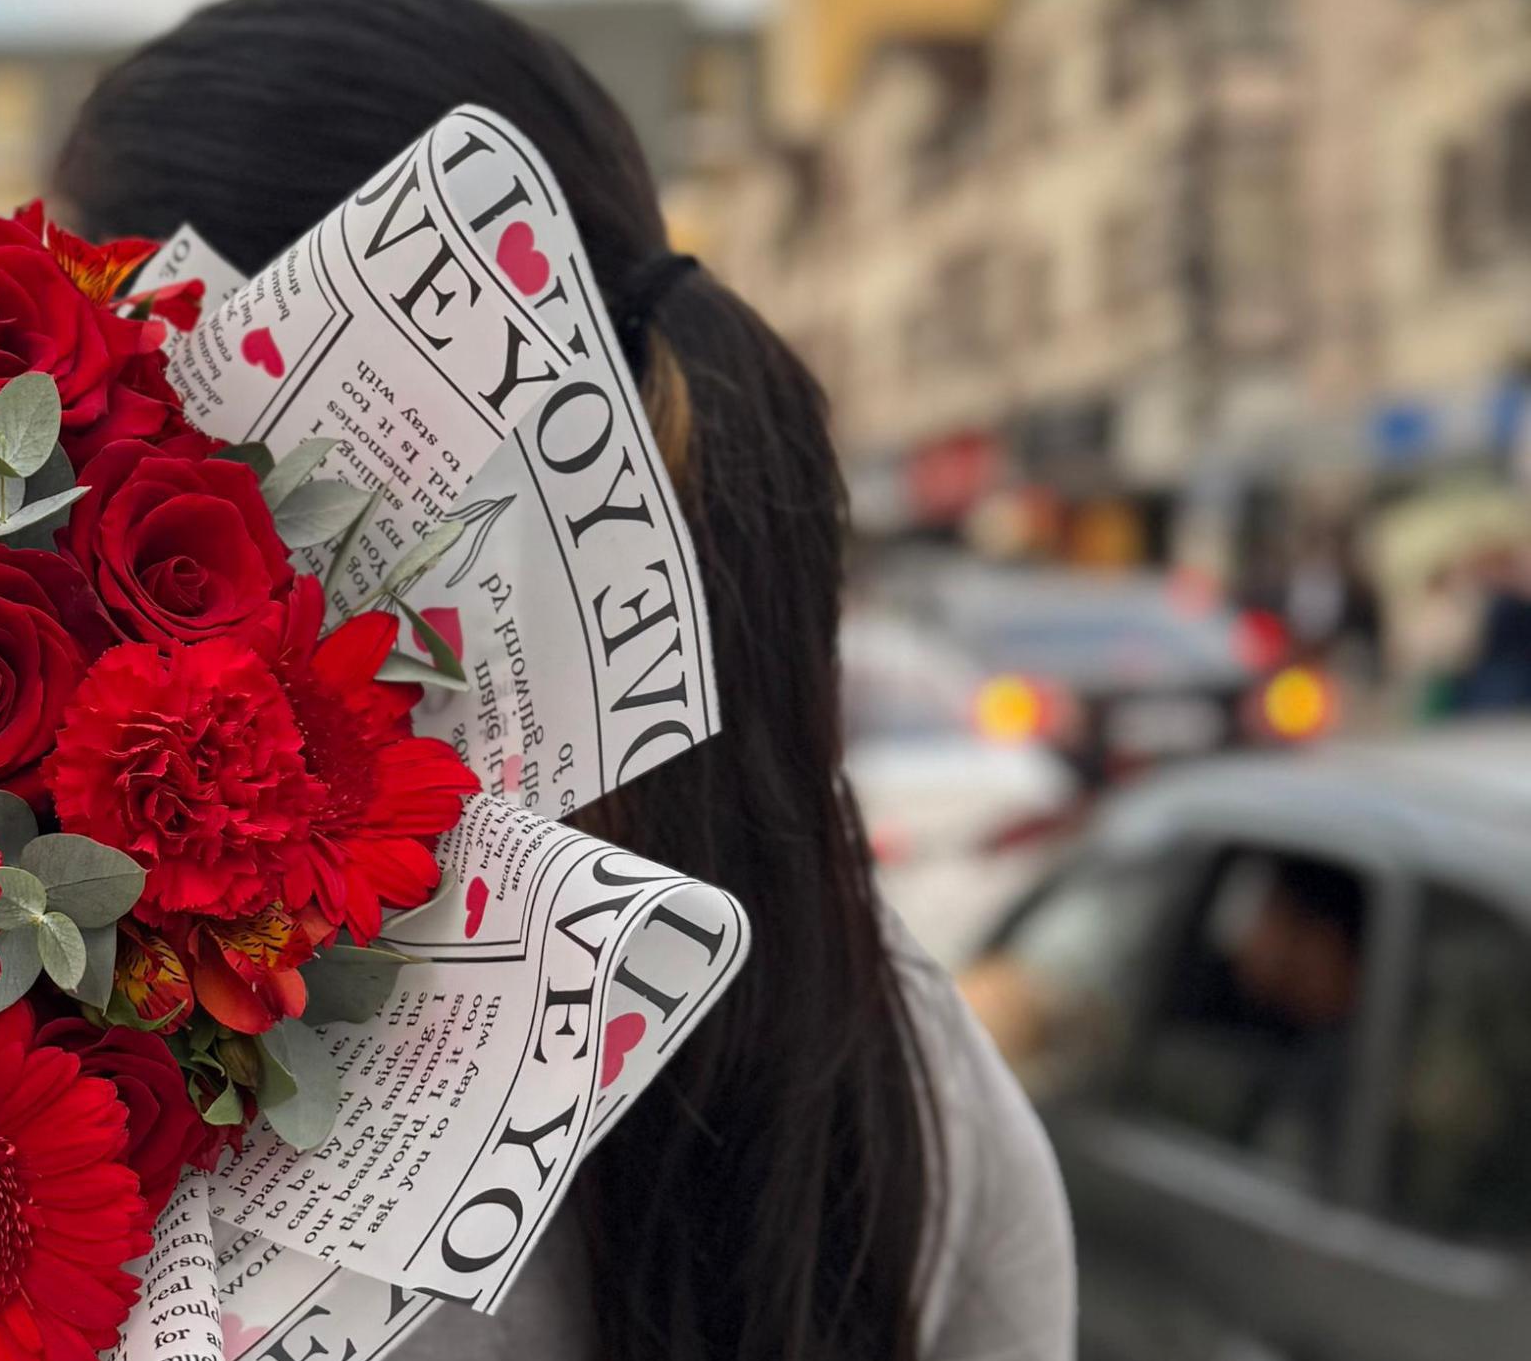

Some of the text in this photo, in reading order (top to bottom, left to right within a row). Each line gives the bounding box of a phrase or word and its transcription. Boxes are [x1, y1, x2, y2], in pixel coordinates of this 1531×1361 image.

[341, 381, 371, 414] too
[357, 360, 461, 473] to stay with
[326, 399, 412, 487] memories
[377, 416, 396, 435] it
[399, 440, 421, 464] Is
[376, 517, 406, 551] my
[475, 809, 494, 849] your
[492, 826, 515, 860] love
[480, 842, 493, 870] but
[495, 837, 523, 902] because
[359, 1043, 386, 1077] are
[388, 990, 410, 1026] the
[266, 1199, 287, 1221] to
[287, 1167, 316, 1192] be
[316, 1136, 341, 1162] by
[344, 1096, 374, 1128] my
[375, 1040, 410, 1087] side,
[406, 990, 428, 1028] the
[287, 1181, 331, 1231] can't
[338, 1125, 376, 1170] stop
[381, 1022, 436, 1111] smiling.
[433, 992, 446, 1002] I
[304, 1207, 335, 1244] our
[333, 1112, 408, 1202] beautiful
[406, 992, 465, 1106] memories
[339, 993, 483, 1232] this world. Is it too
[347, 994, 502, 1252] I ask you to stay with
[219, 1139, 257, 1180] now
[147, 1275, 193, 1310] real
[154, 1327, 191, 1350] for
